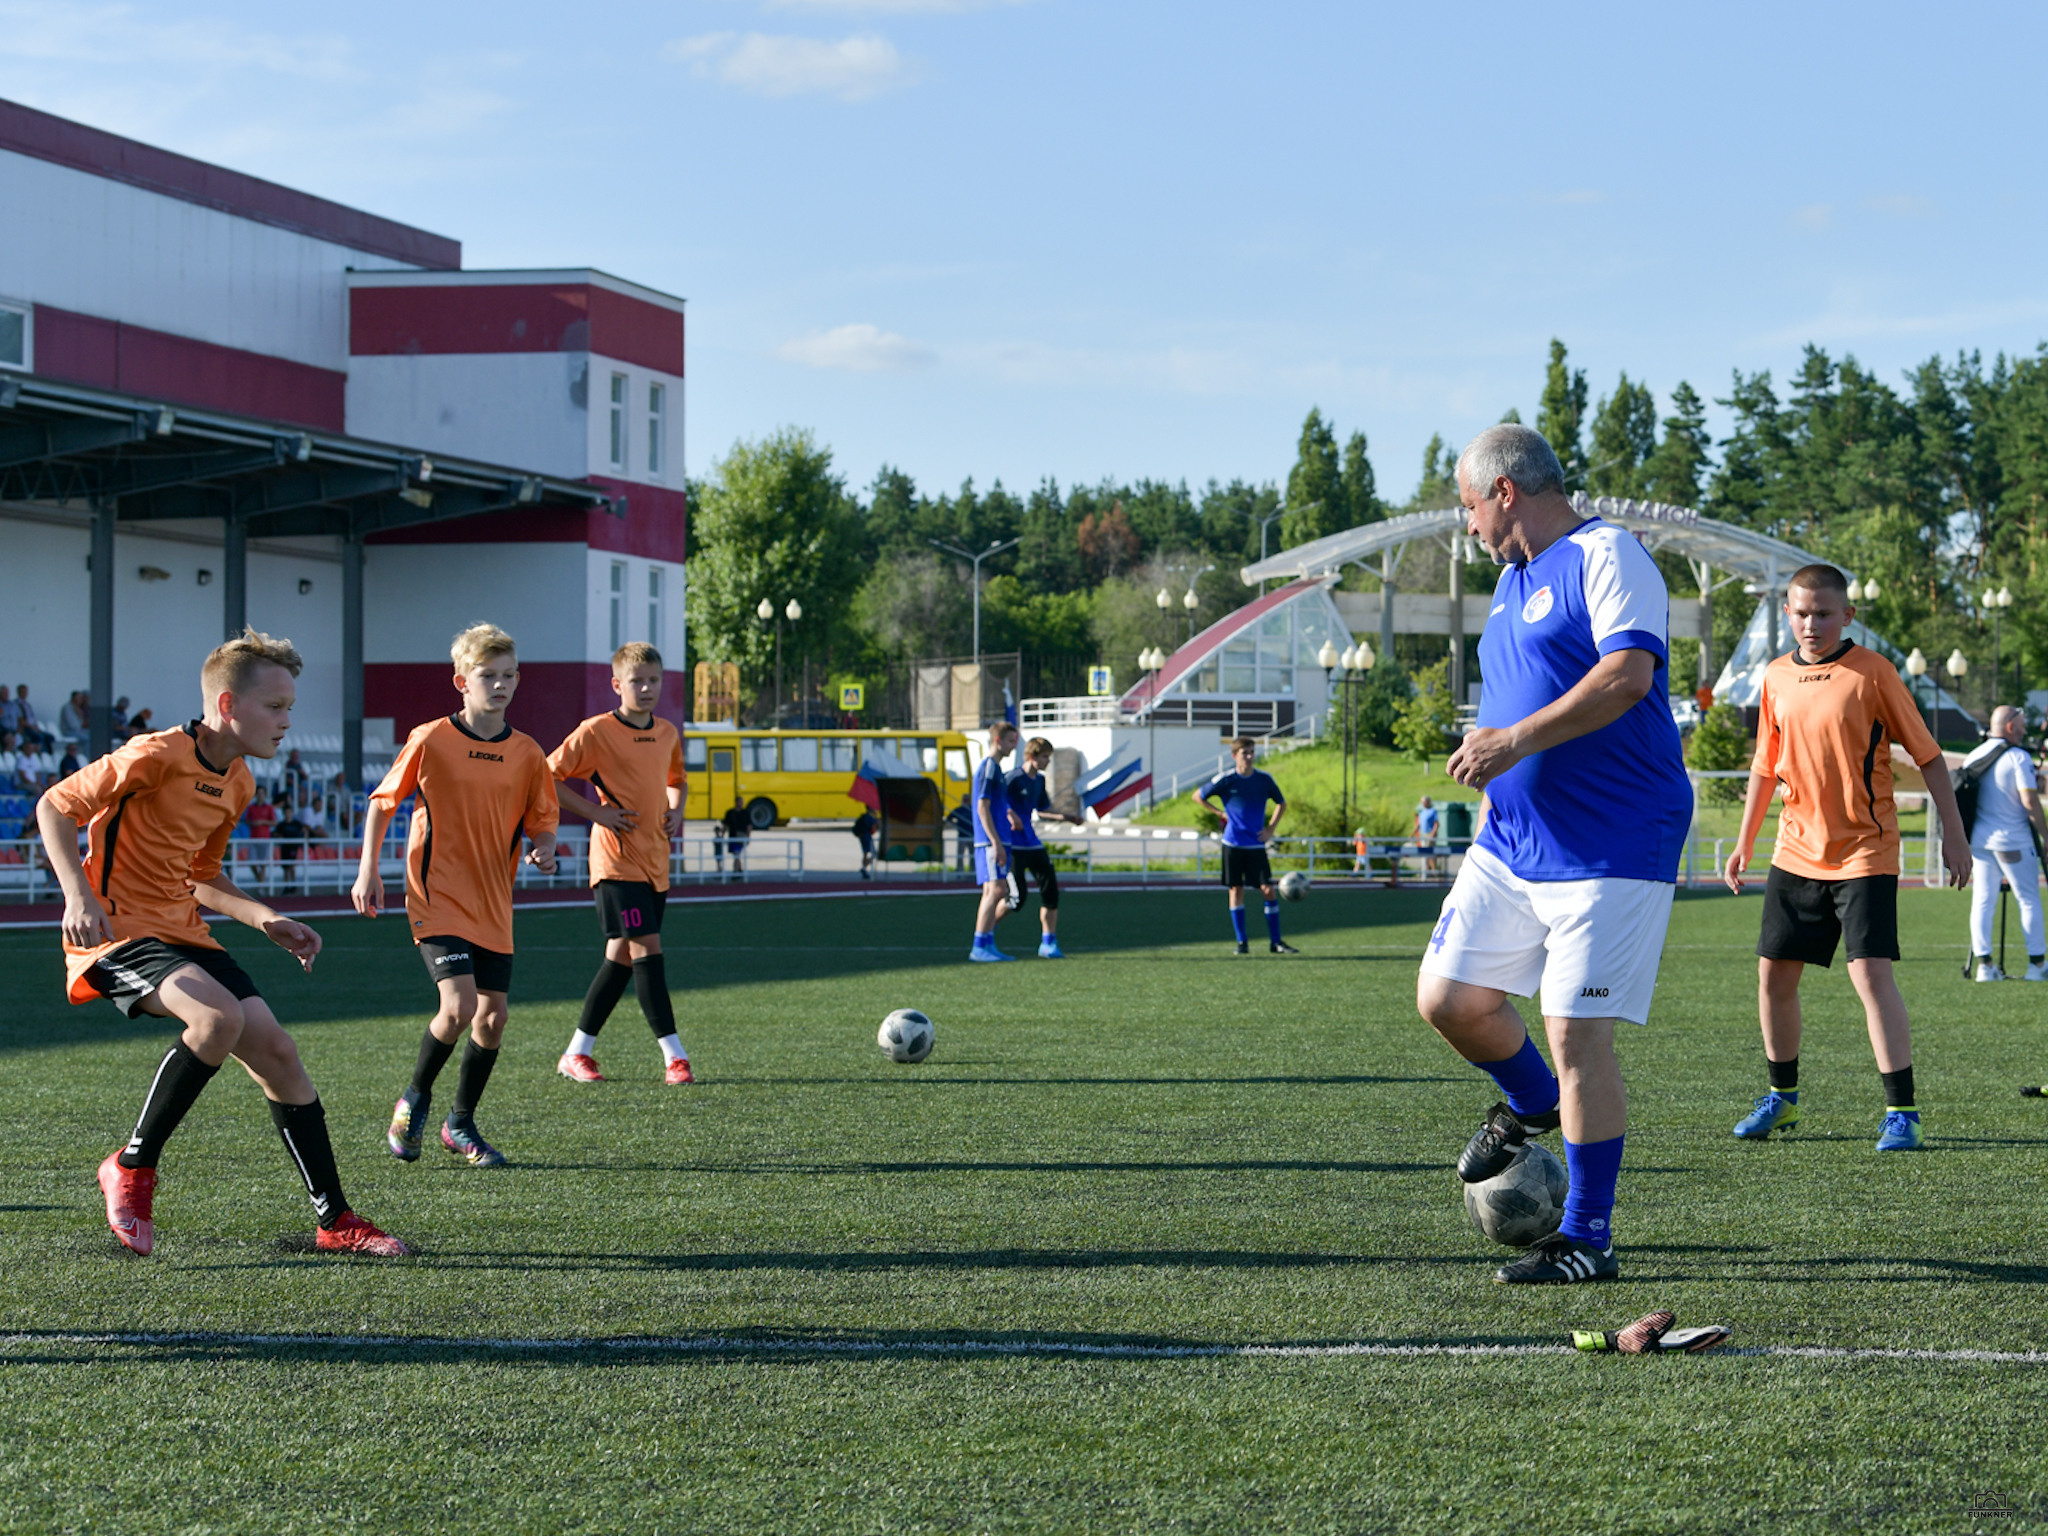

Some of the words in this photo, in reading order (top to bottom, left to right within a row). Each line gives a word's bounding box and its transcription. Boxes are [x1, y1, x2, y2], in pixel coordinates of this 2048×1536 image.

[468, 750, 504, 763] LEGEA
[620, 907, 642, 929] 10
[1580, 987, 1609, 998] JAKO
